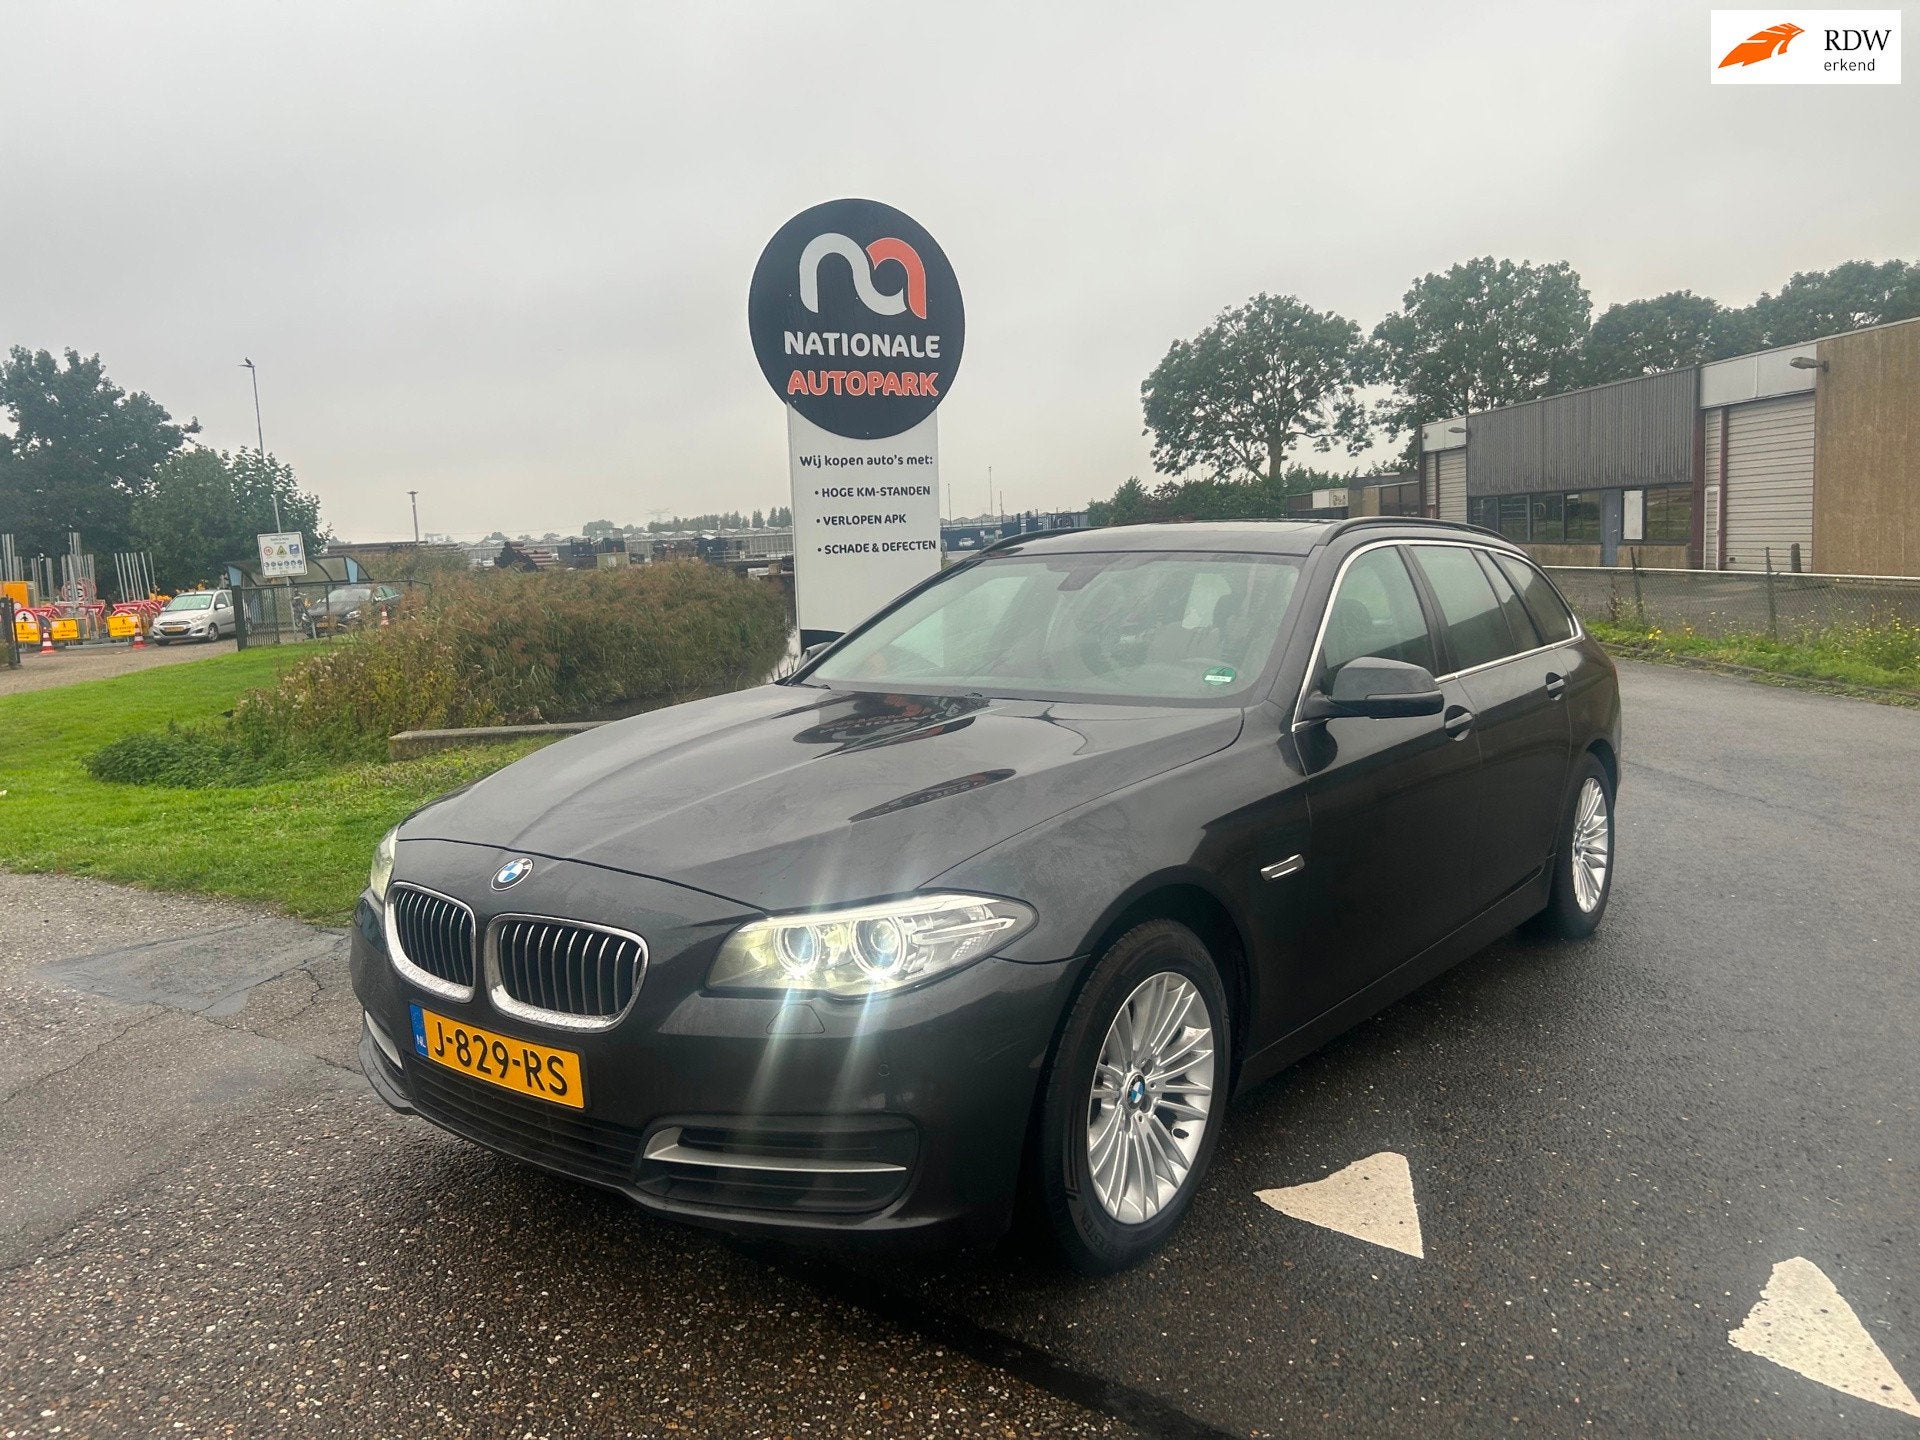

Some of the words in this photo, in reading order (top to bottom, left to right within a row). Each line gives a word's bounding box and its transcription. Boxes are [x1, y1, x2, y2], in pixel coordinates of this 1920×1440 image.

[784, 331, 941, 358] NATIONALE
[787, 370, 938, 396] AUTOPARK
[800, 455, 822, 468] Wij
[825, 455, 864, 467] kopen
[906, 455, 933, 465] met:
[821, 487, 855, 498] HOGE
[856, 485, 931, 497] KM-STANDEN
[823, 514, 882, 526] VERLOPEN
[884, 513, 907, 525] APK
[824, 542, 870, 555] SCHADE
[871, 543, 880, 553] &
[881, 540, 937, 552] DEFECTEN
[434, 1021, 568, 1096] J-829-RS
